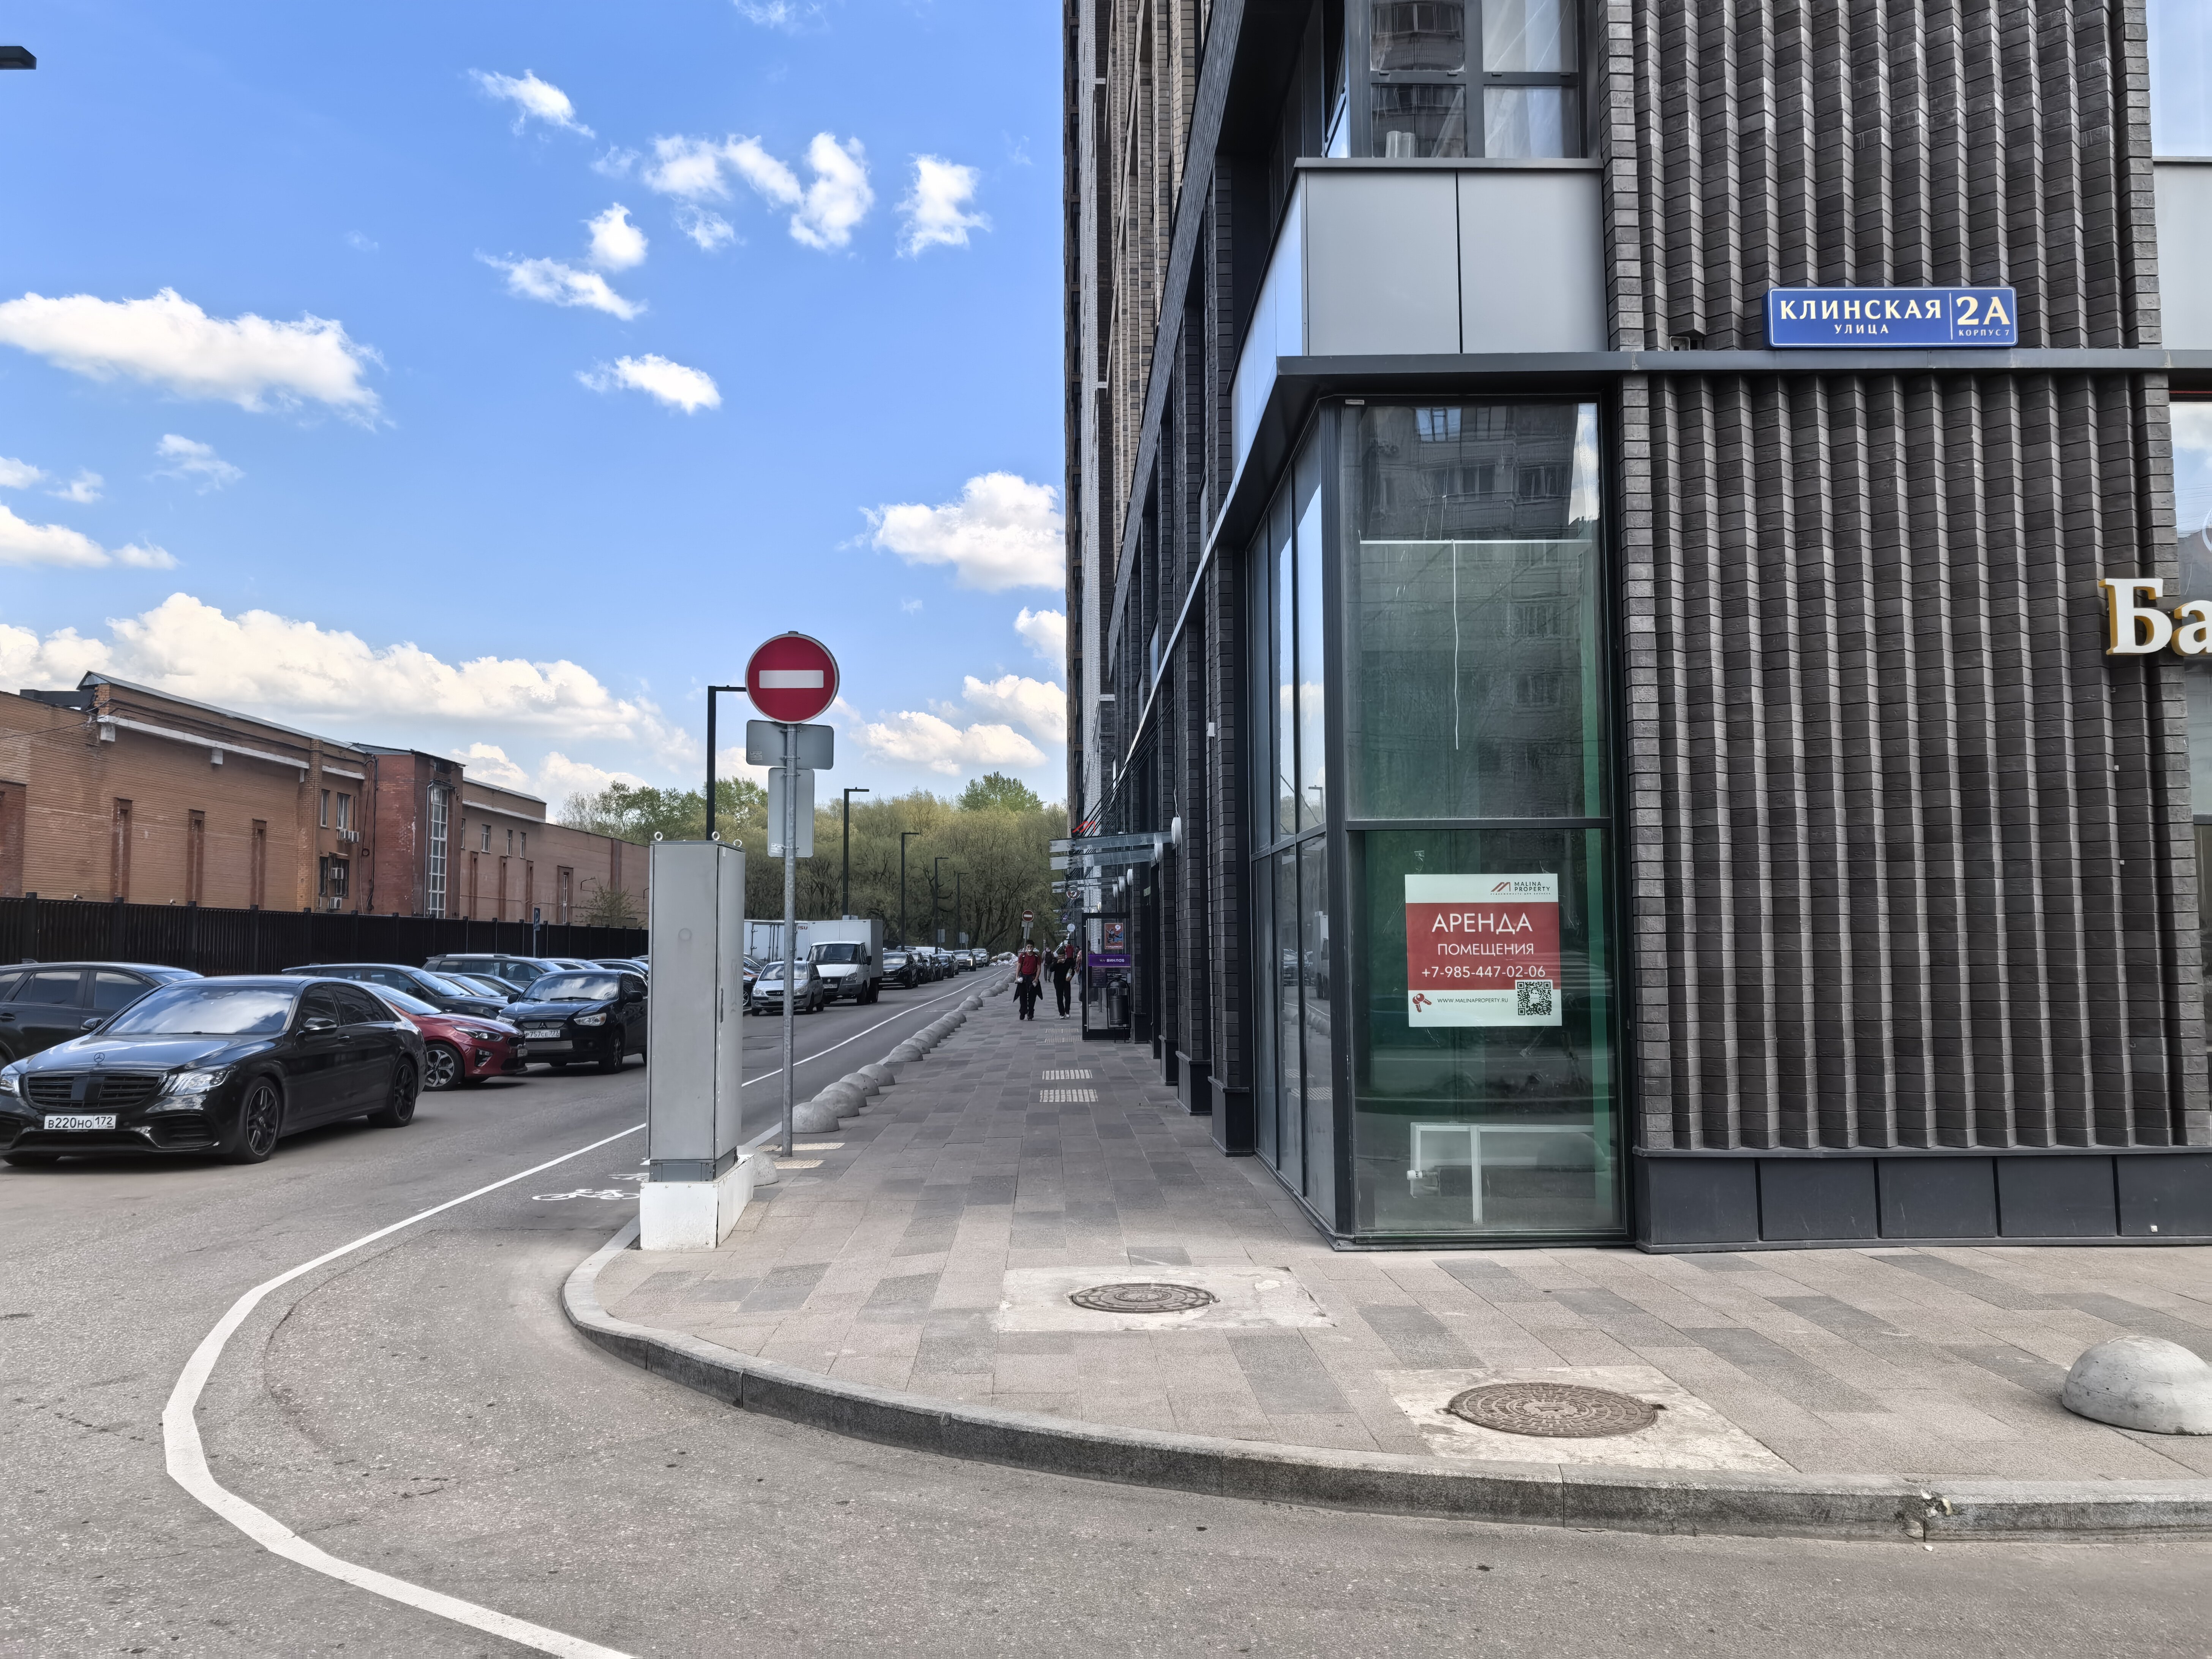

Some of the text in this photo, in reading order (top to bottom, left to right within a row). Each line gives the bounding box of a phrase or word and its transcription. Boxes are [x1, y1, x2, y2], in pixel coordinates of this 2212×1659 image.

[1780, 299, 1942, 320] КЛИНСКАЯ
[1956, 296, 2011, 325] 2А
[1834, 324, 1889, 335] УЛИЦА
[1431, 912, 1533, 935] АРЕНДА
[1438, 943, 1534, 956] ПОМЕЩЕНИЯ
[1422, 965, 1546, 978] +7-985-447-02-06
[48, 1116, 113, 1128] В220НО 172
